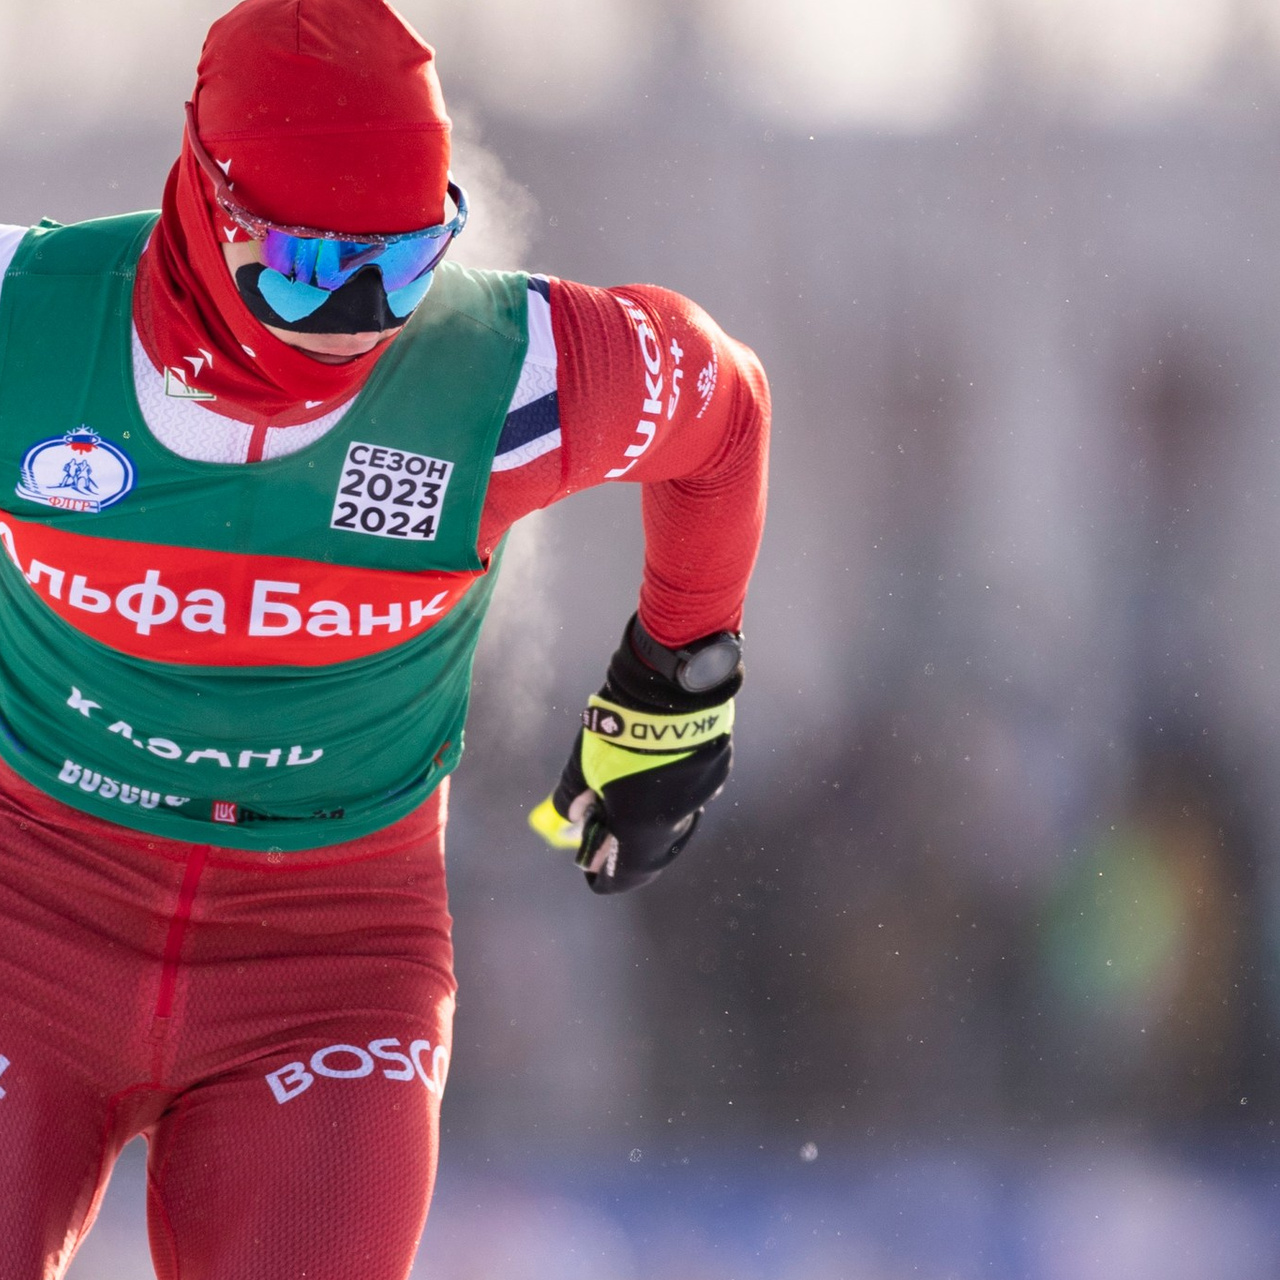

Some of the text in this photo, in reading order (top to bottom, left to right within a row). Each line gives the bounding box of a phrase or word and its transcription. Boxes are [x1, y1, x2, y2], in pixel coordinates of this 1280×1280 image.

[349, 445, 448, 480] СЕЗОН
[48, 496, 91, 512] ФЛГР
[340, 468, 442, 509] 2023
[333, 501, 435, 538] 2024
[247, 578, 450, 638] Банк
[264, 1037, 448, 1105] BOSCO
